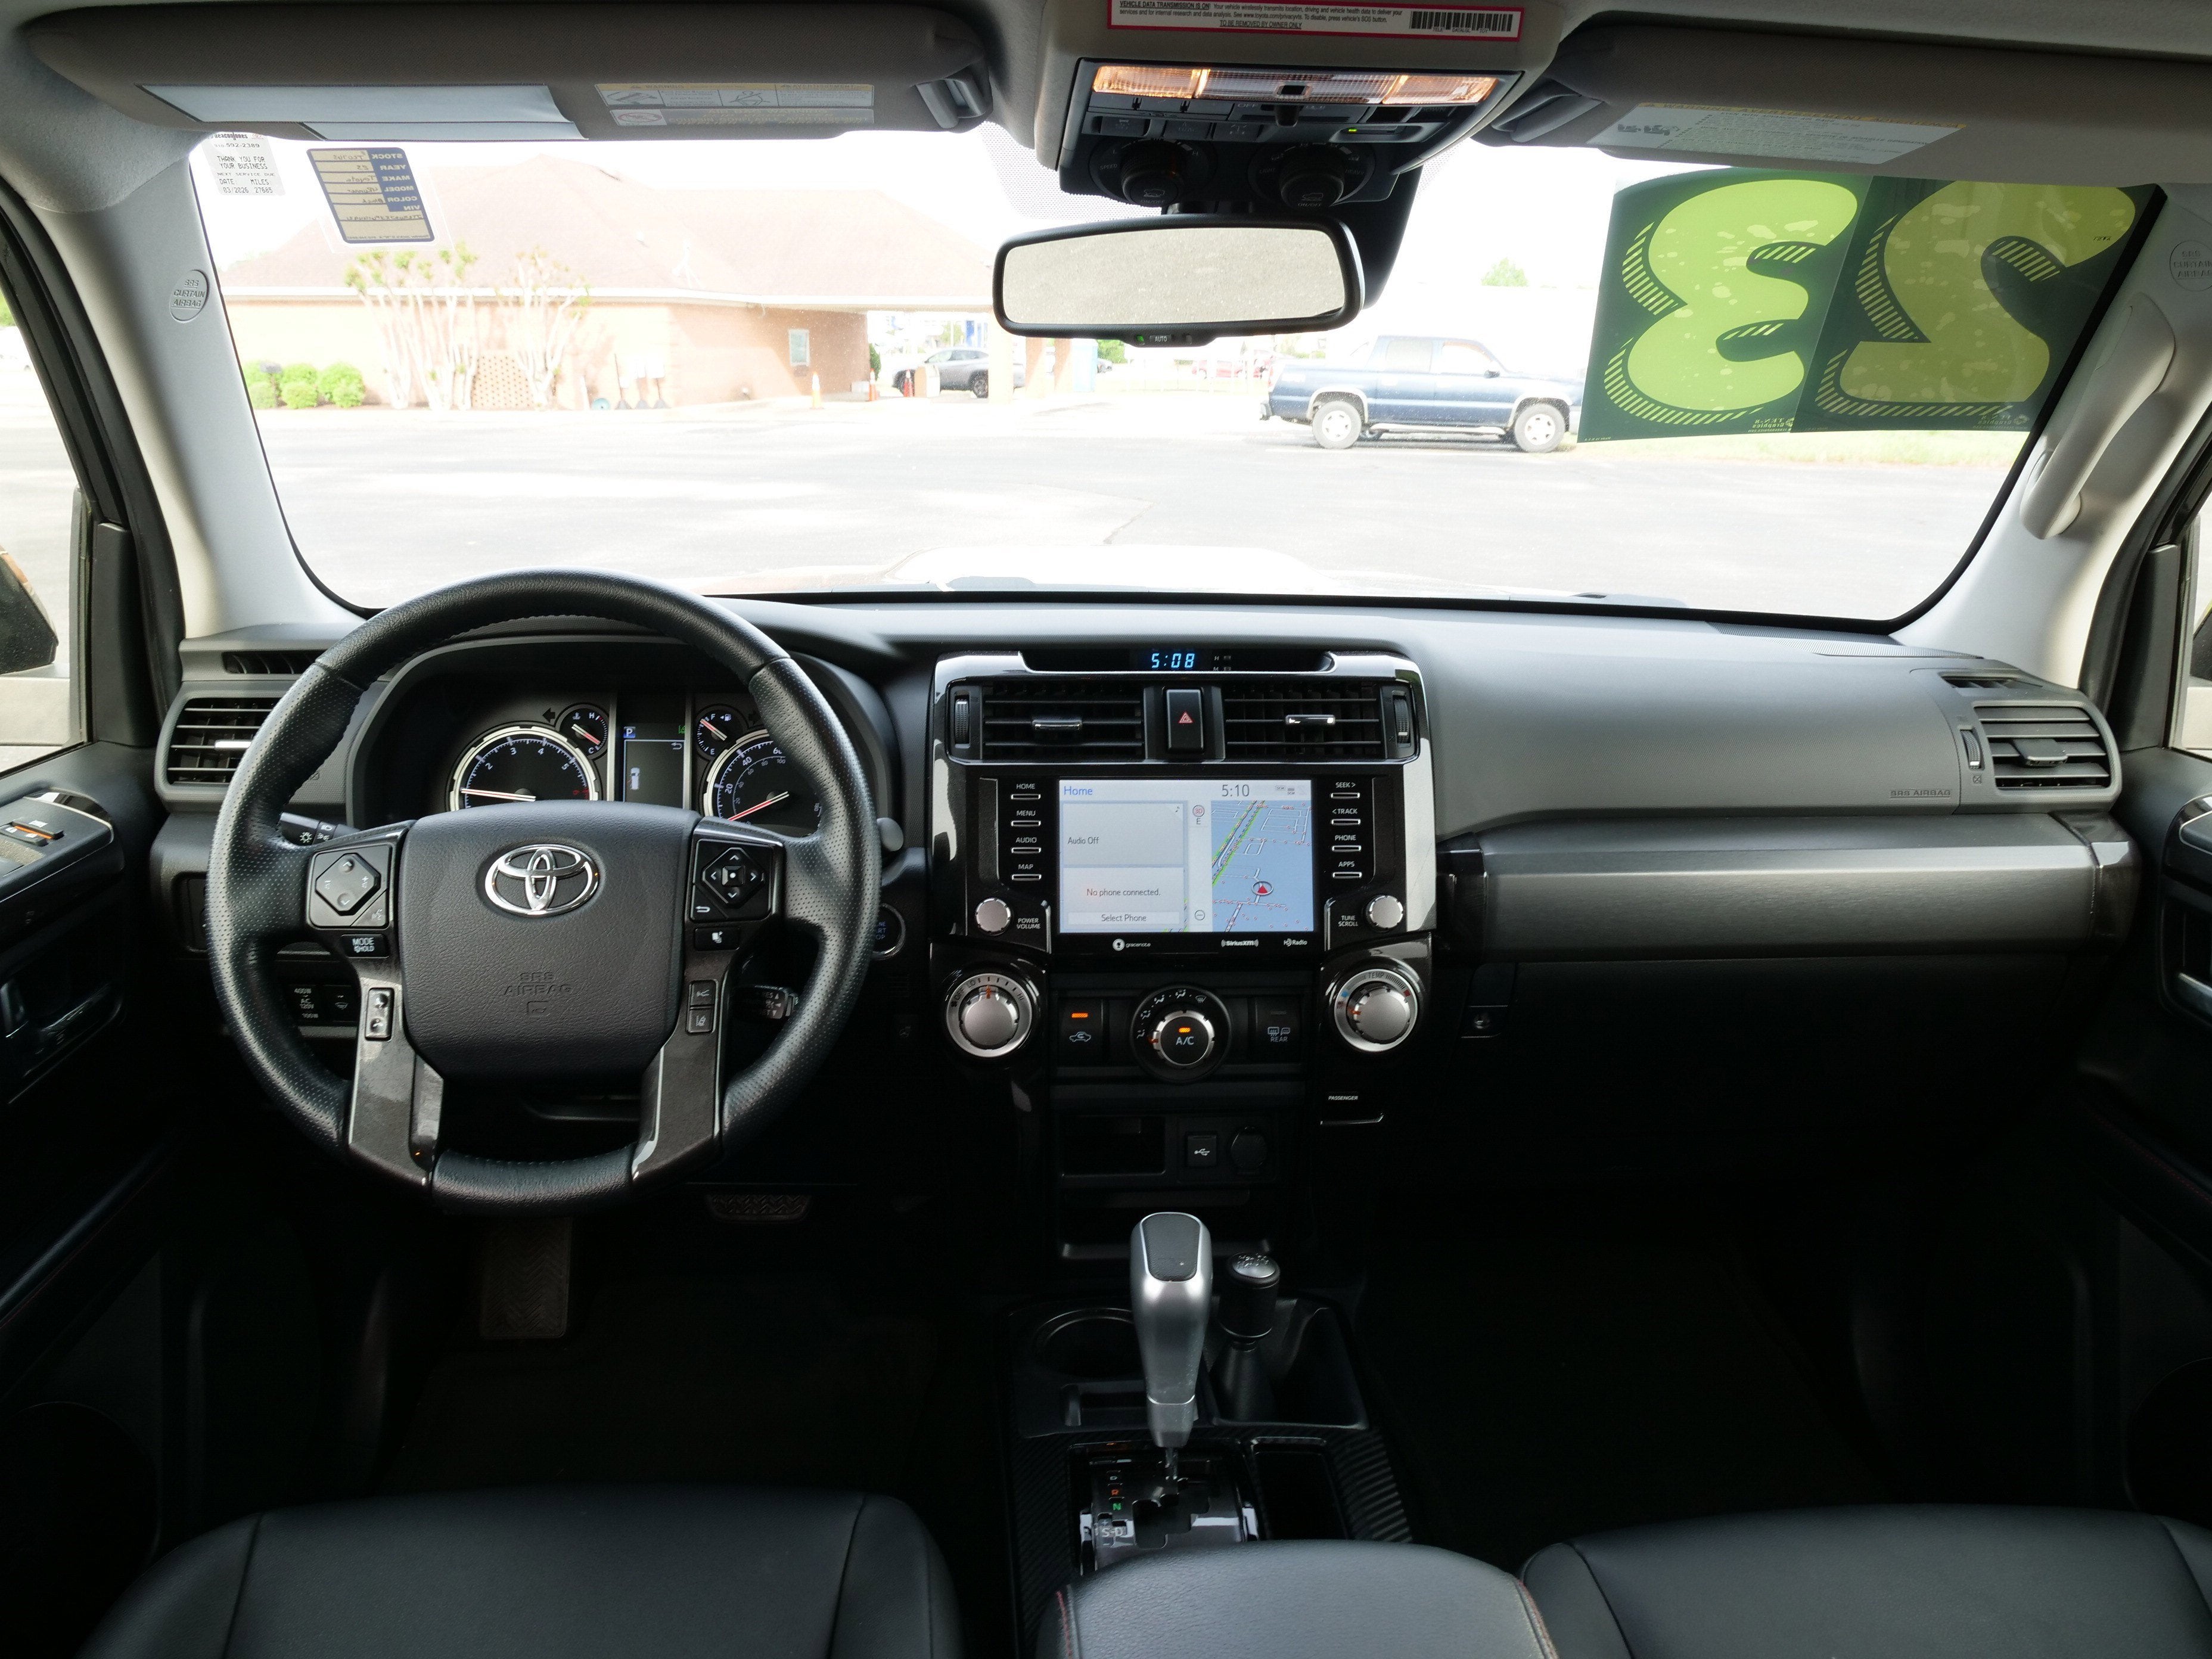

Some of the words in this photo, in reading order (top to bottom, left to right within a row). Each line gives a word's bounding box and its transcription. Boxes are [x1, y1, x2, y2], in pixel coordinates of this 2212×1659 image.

[173, 289, 206, 298] CURTAIN
[173, 299, 201, 307] AIRBAG
[1151, 653, 1195, 669] 5:08
[589, 712, 595, 720] H
[625, 728, 633, 737] P
[510, 747, 518, 756] 3
[538, 747, 545, 756] 4
[742, 756, 753, 766] 40
[485, 762, 493, 771] 2
[561, 762, 570, 771] 5
[725, 783, 734, 794] 20
[1063, 785, 1093, 796] Home
[1221, 784, 1251, 797] 5:10
[1086, 888, 1097, 896] No
[1099, 888, 1121, 897] phone
[1122, 888, 1161, 896] connected.
[352, 937, 375, 946] MODE
[1175, 1036, 1195, 1046] A/C
